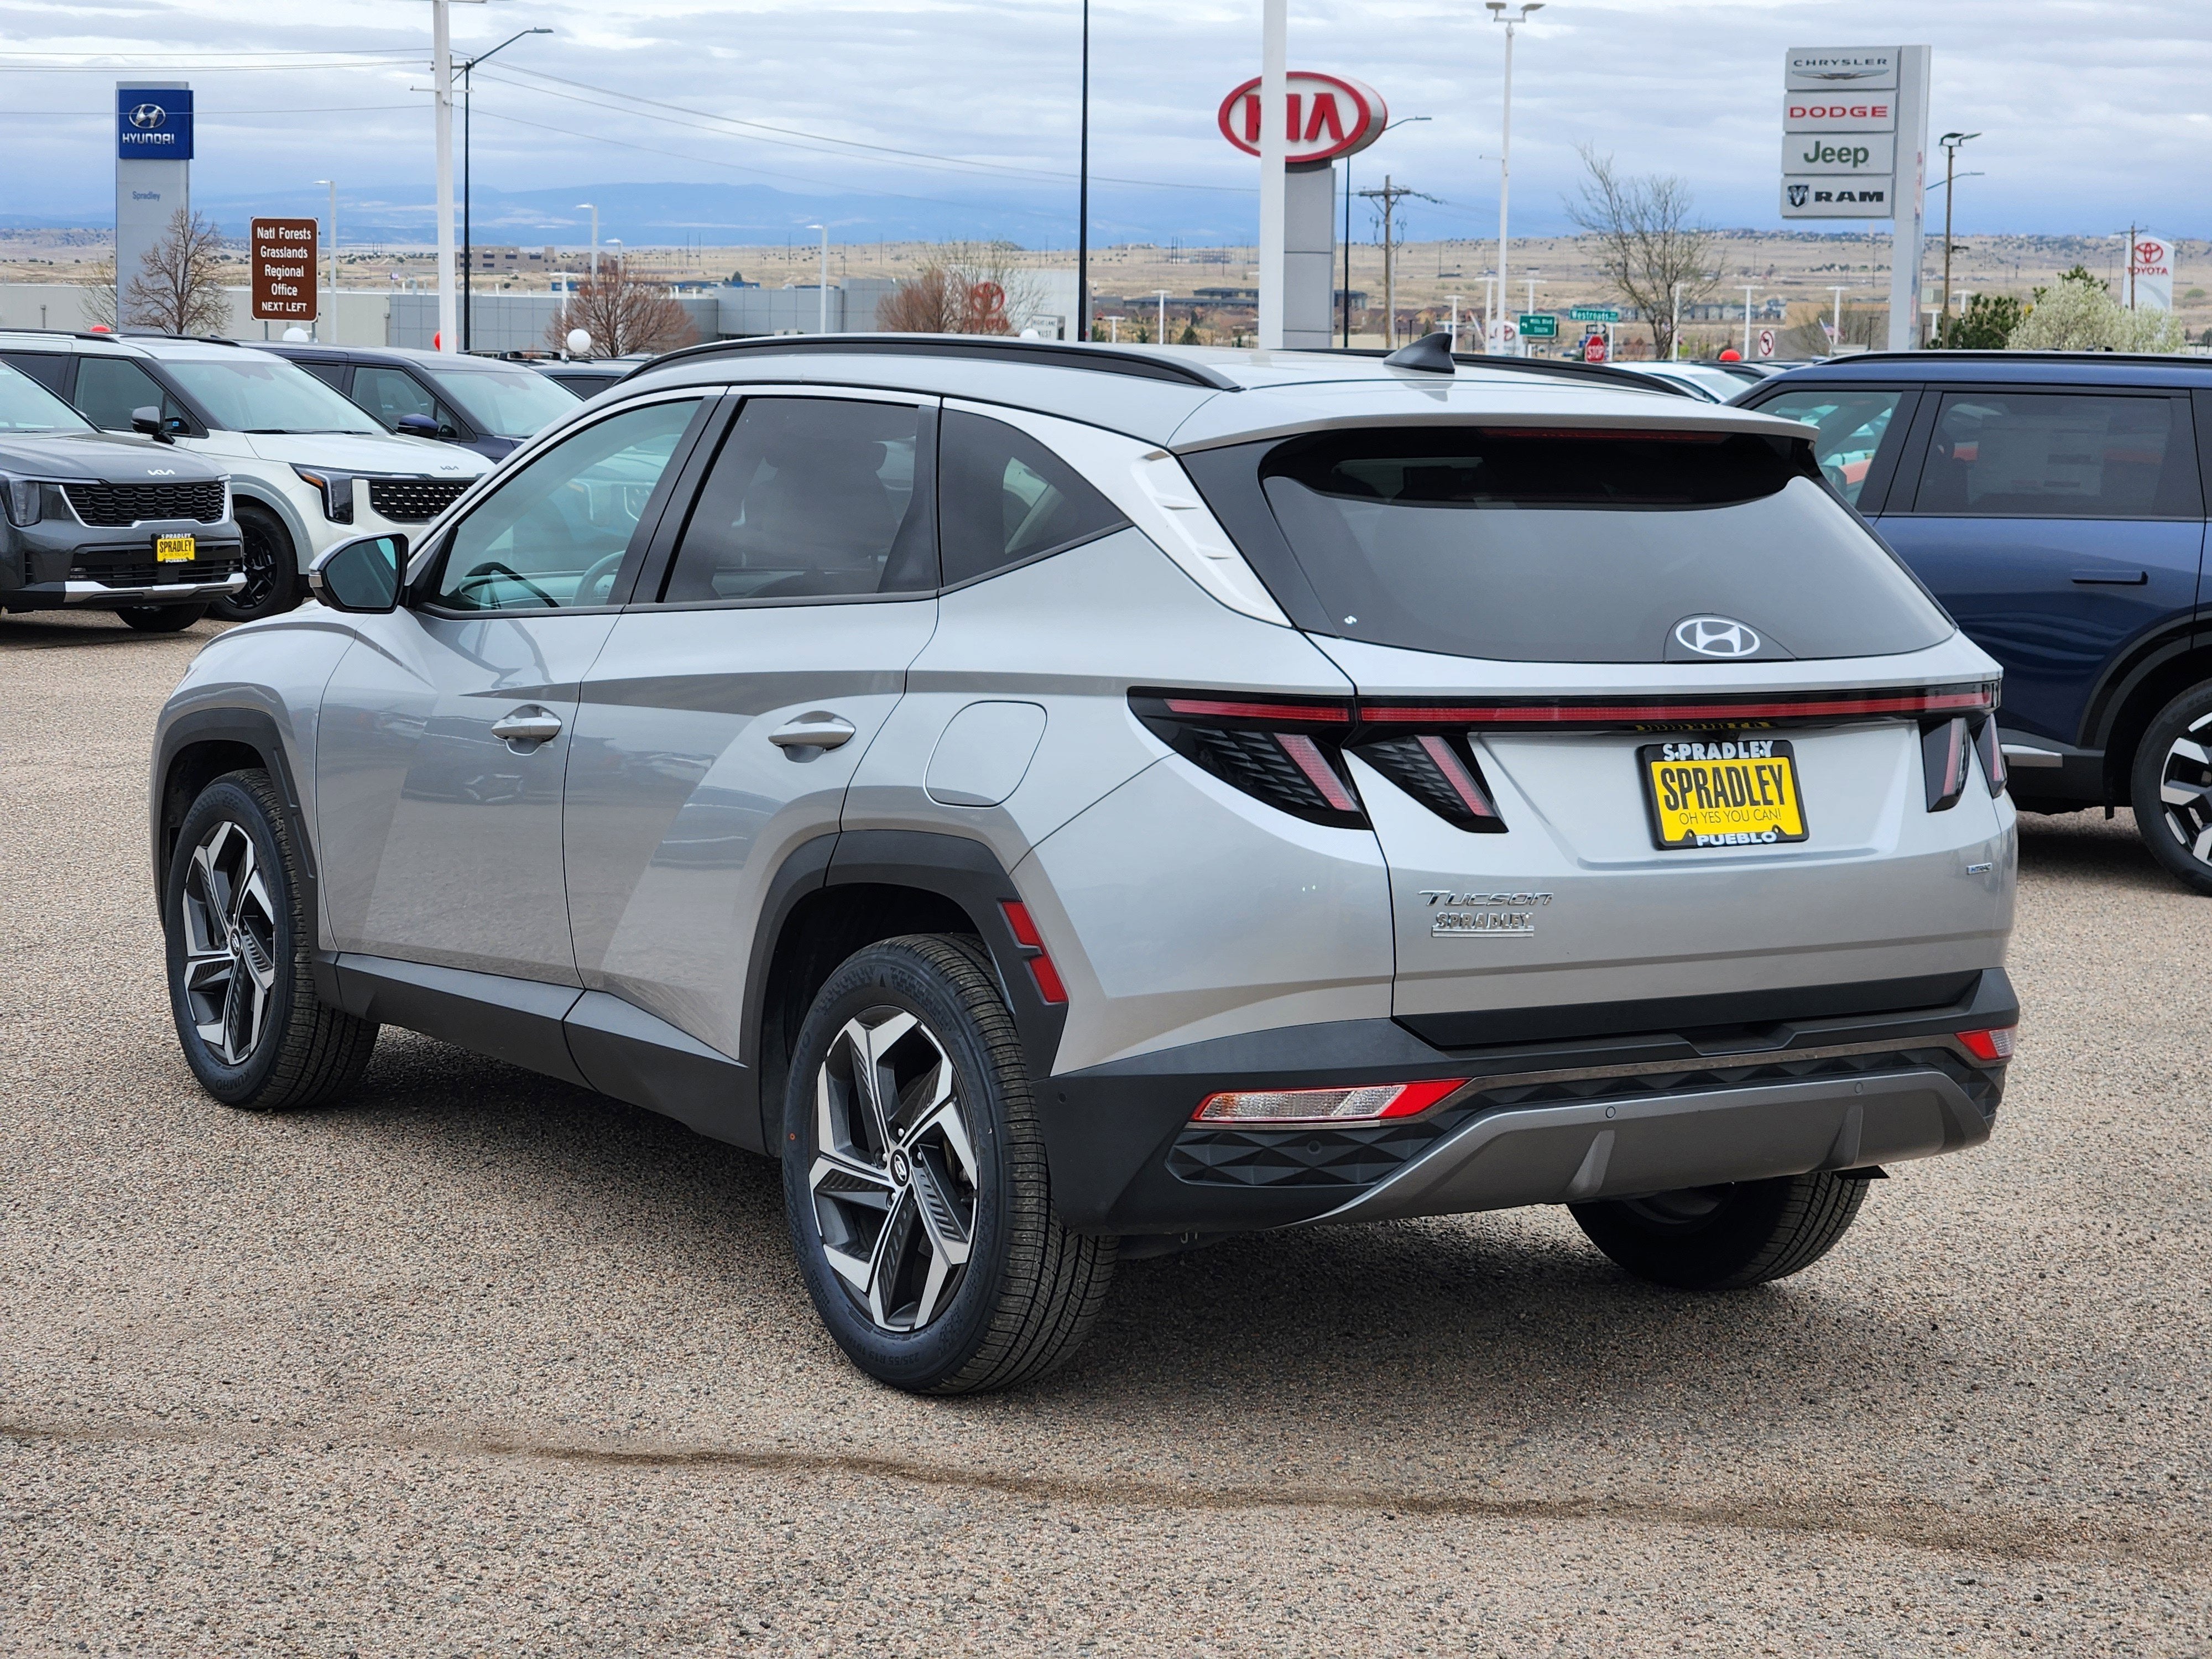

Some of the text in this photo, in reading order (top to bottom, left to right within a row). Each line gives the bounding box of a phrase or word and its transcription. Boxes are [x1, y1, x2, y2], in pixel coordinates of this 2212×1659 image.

[1793, 58, 1887, 67] CHRYSLER
[1790, 106, 1888, 118] DODGE
[122, 133, 175, 144] HYUNDAI
[1803, 140, 1869, 168] Jeep
[132, 191, 160, 201] Spradley
[1814, 191, 1884, 202] RAM
[257, 227, 311, 240] Natl Forests
[260, 246, 309, 259] Grasslands
[264, 264, 304, 280] Regional
[2127, 267, 2169, 275] TOYOTA
[271, 283, 298, 296] Office
[262, 301, 307, 312] NEXT LEFT
[1588, 345, 1604, 359] STOP
[159, 540, 192, 553] SPRADLEY
[1662, 740, 1773, 761] SPRADLEY
[1660, 764, 1785, 811] SPRADLEY
[1679, 808, 1782, 825] OH YES YOU CAN!
[1695, 832, 1777, 847] PUEBLO
[1436, 911, 1533, 930] SPRADLEY
